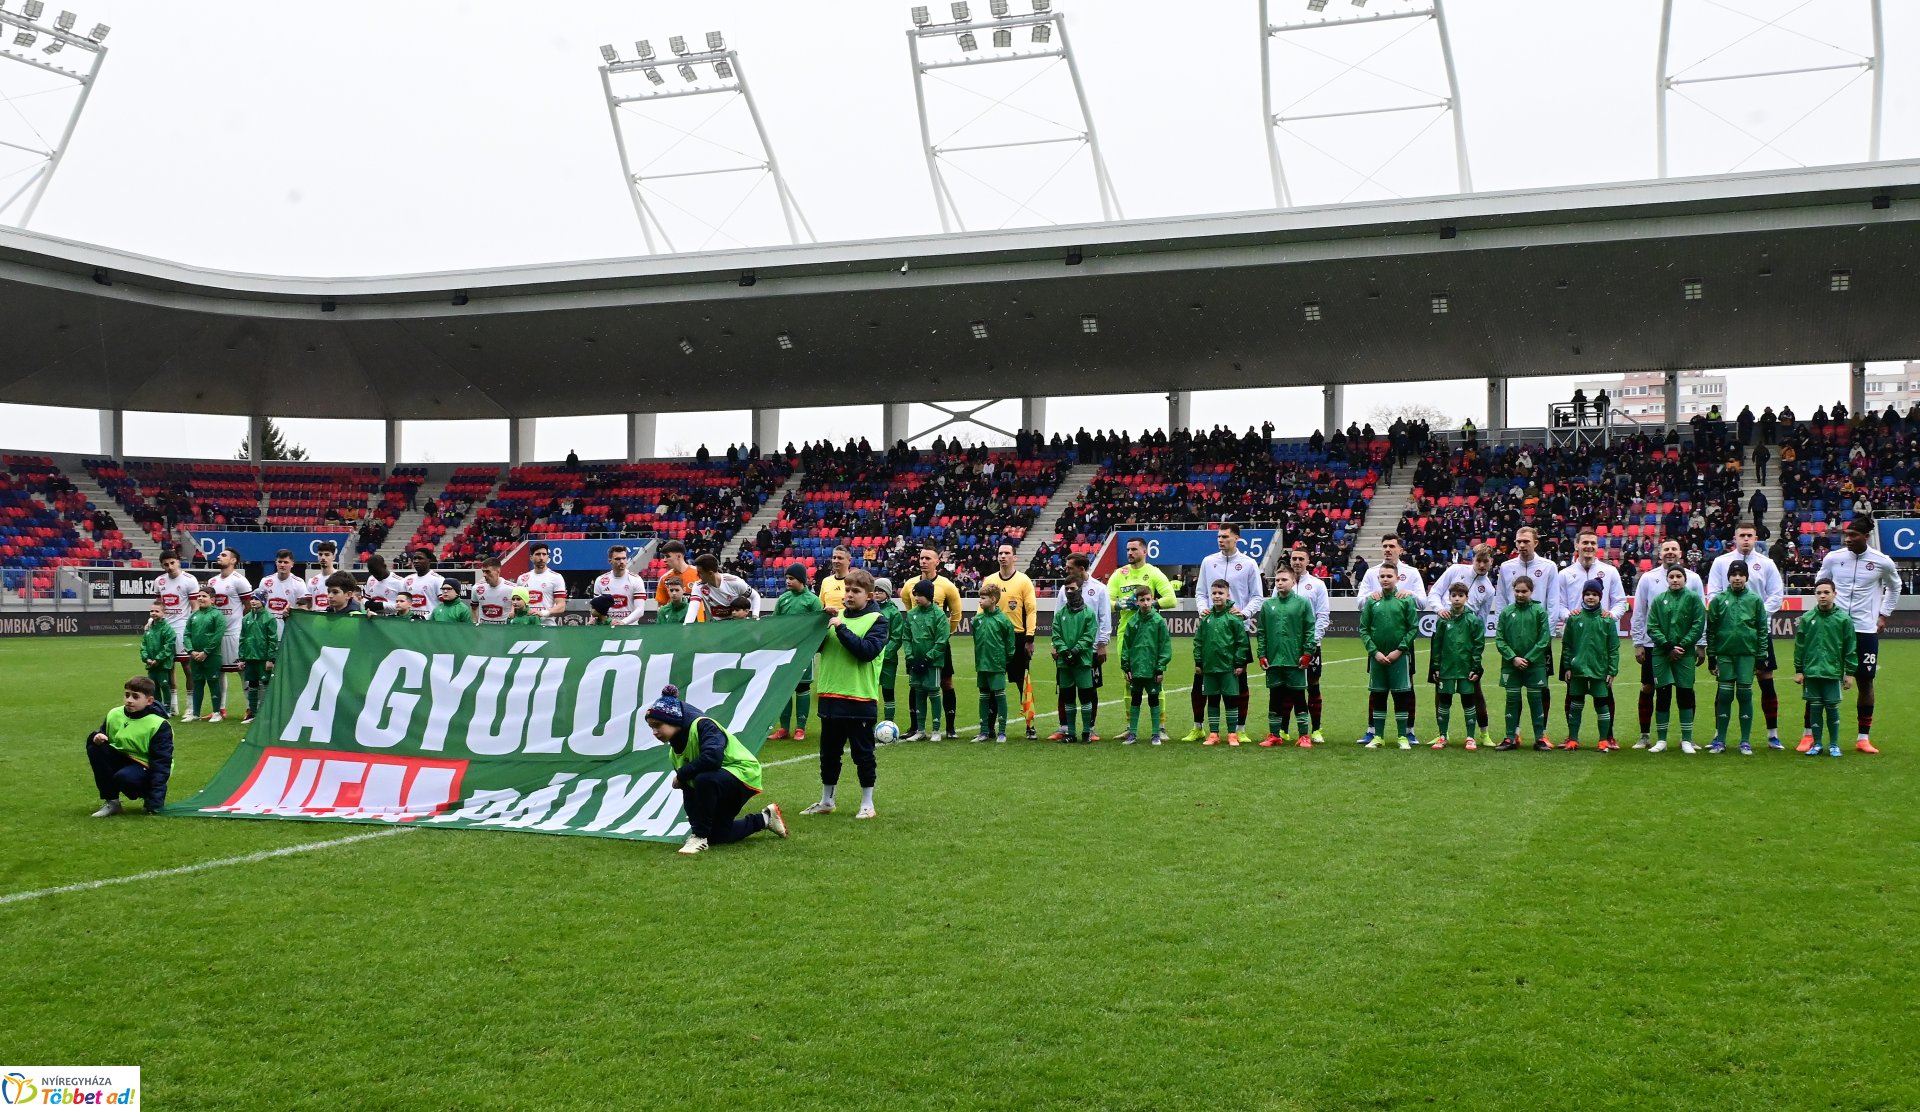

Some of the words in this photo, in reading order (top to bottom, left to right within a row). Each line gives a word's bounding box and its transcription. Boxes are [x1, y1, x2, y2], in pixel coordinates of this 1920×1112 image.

[200, 538, 226, 555] D1
[1894, 528, 1920, 550] C
[547, 547, 563, 565] 8
[120, 577, 144, 594] HAJRÁ
[56, 615, 78, 633] HÚS
[1863, 653, 1876, 664] 26
[280, 645, 350, 743] A
[355, 638, 798, 756] GYŰLÖLET
[218, 756, 457, 818] NEM
